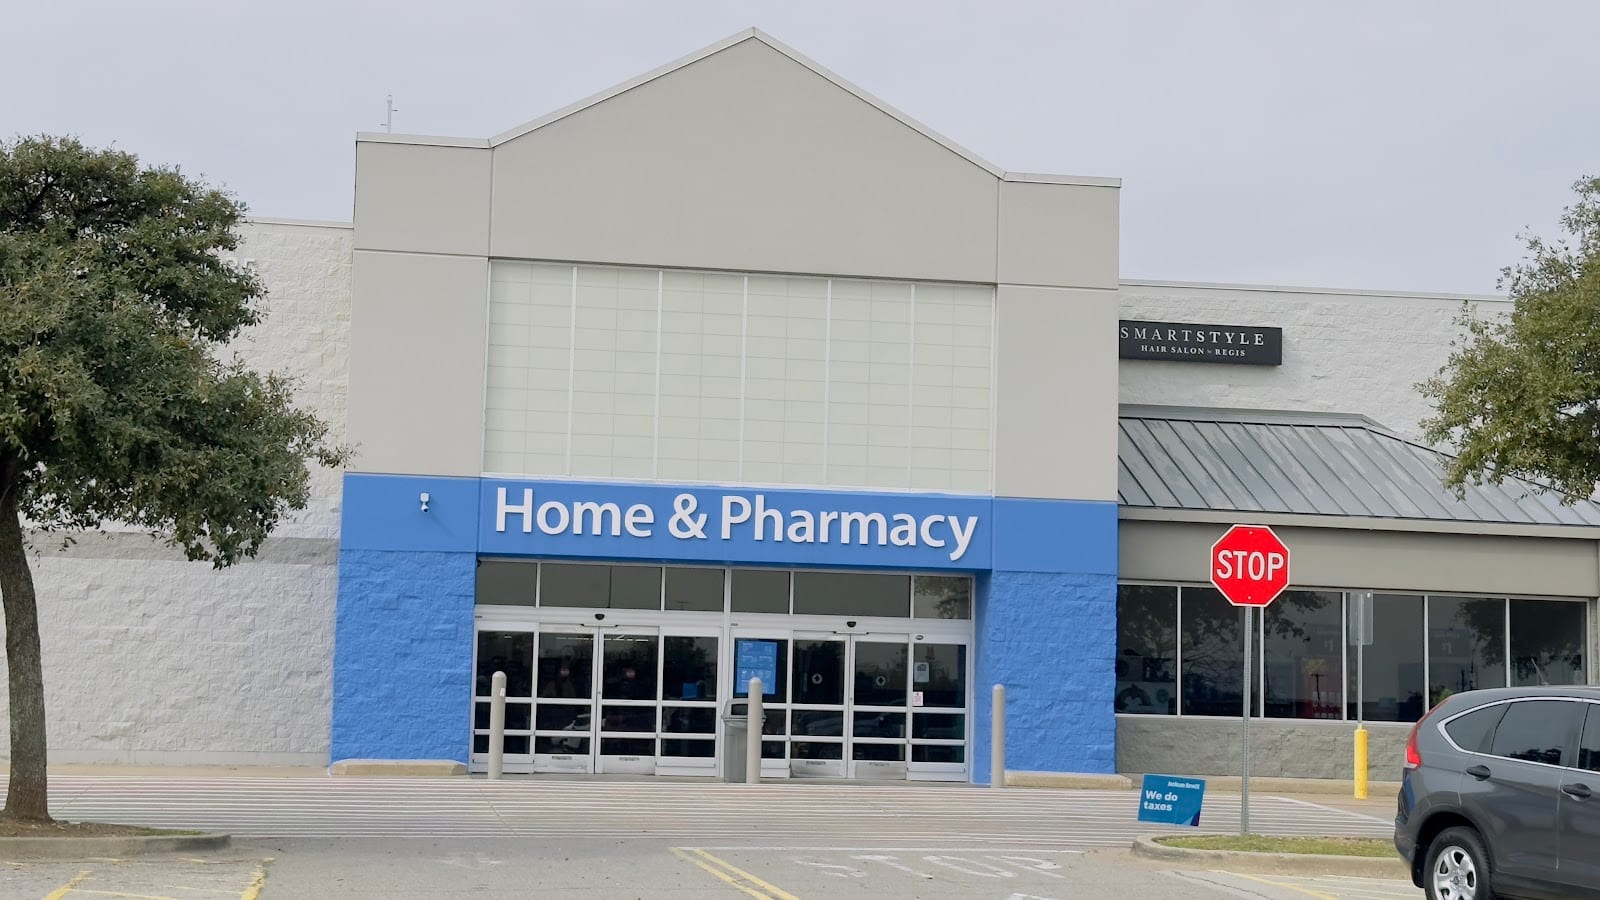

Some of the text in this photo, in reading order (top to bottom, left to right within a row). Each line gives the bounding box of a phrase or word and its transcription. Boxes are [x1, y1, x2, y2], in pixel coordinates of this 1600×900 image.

[1120, 326, 1265, 346] SMARTSTYLE
[1141, 345, 1167, 353] HAIR
[1171, 346, 1204, 355] SALON
[1215, 348, 1246, 357] REGIS
[495, 487, 978, 561] Home & Pharmacy
[1216, 549, 1284, 581] STOP
[1145, 790, 1178, 801] We do
[1143, 801, 1173, 811] taxes
